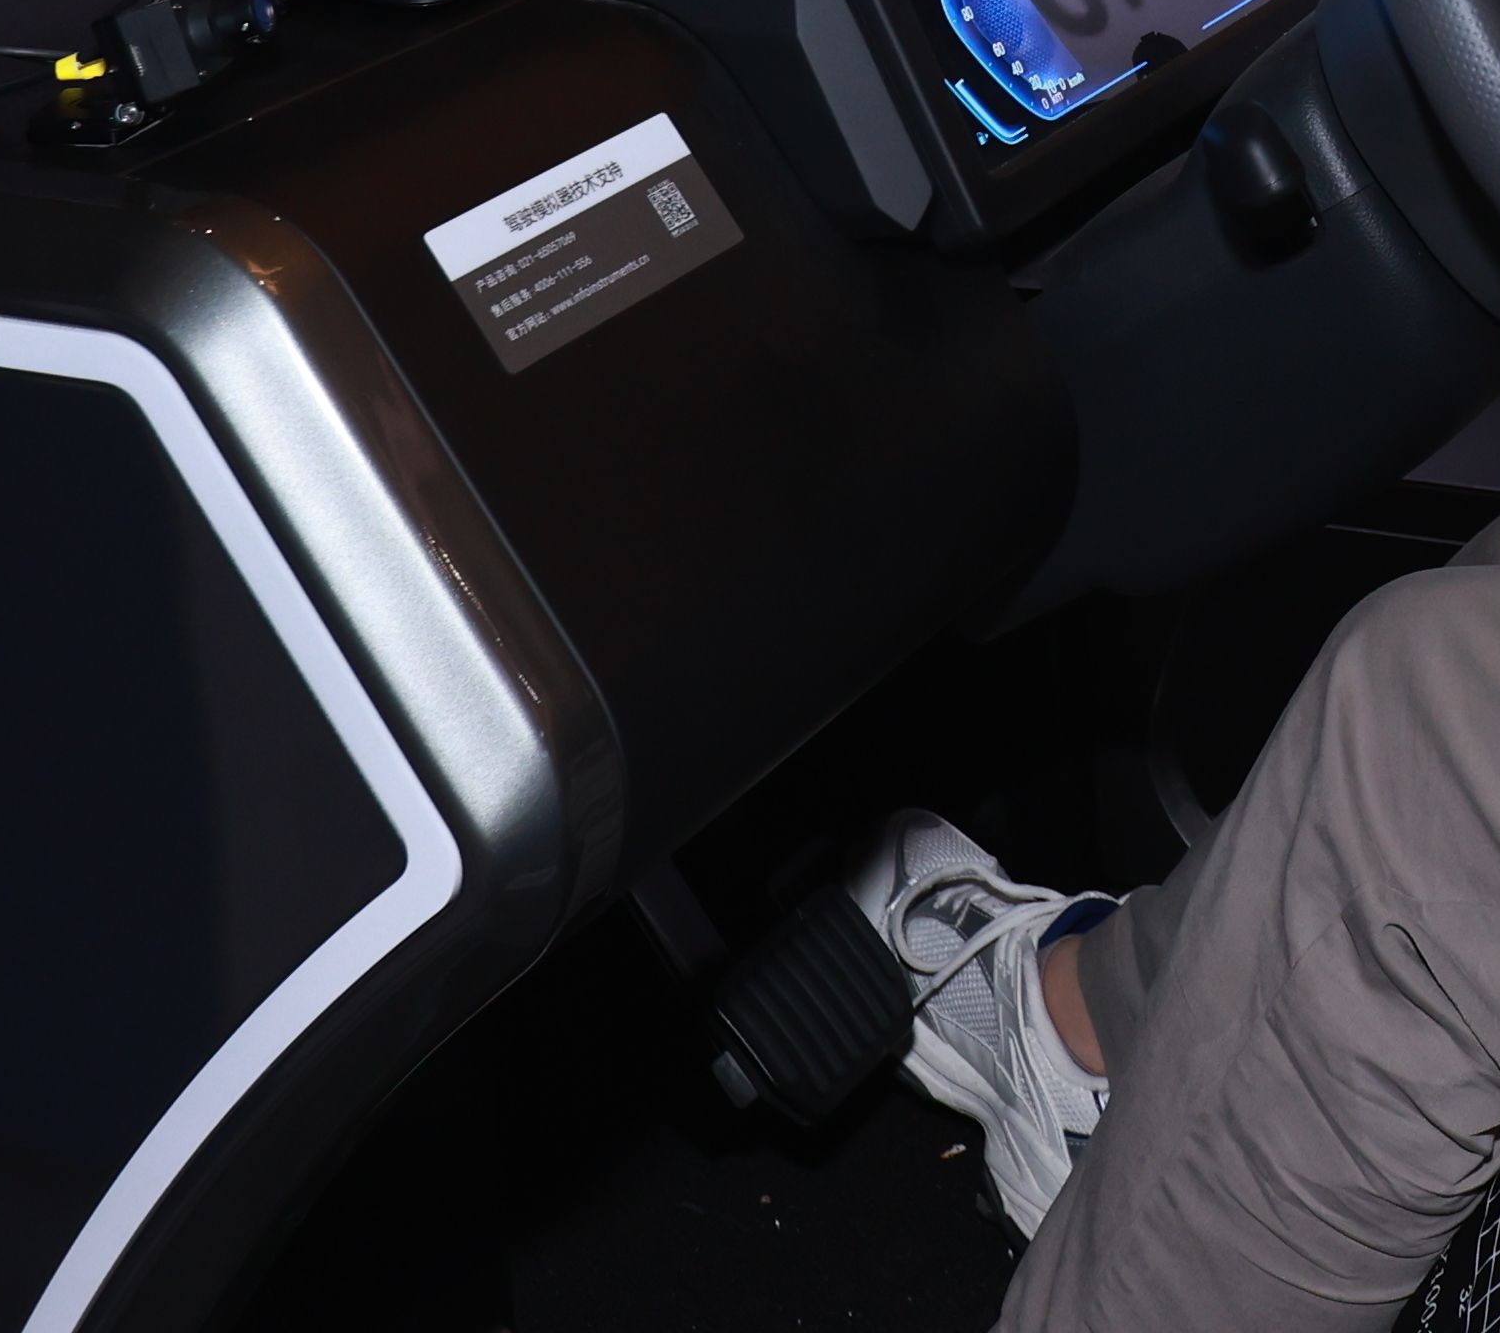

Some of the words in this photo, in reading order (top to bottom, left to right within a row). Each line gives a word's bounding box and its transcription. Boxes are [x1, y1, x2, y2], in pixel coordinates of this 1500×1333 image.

[960, 5, 975, 22] 80
[992, 41, 1006, 58] 60
[1011, 60, 1025, 77] 40
[503, 161, 624, 233] 驾驶模拟器技术支持
